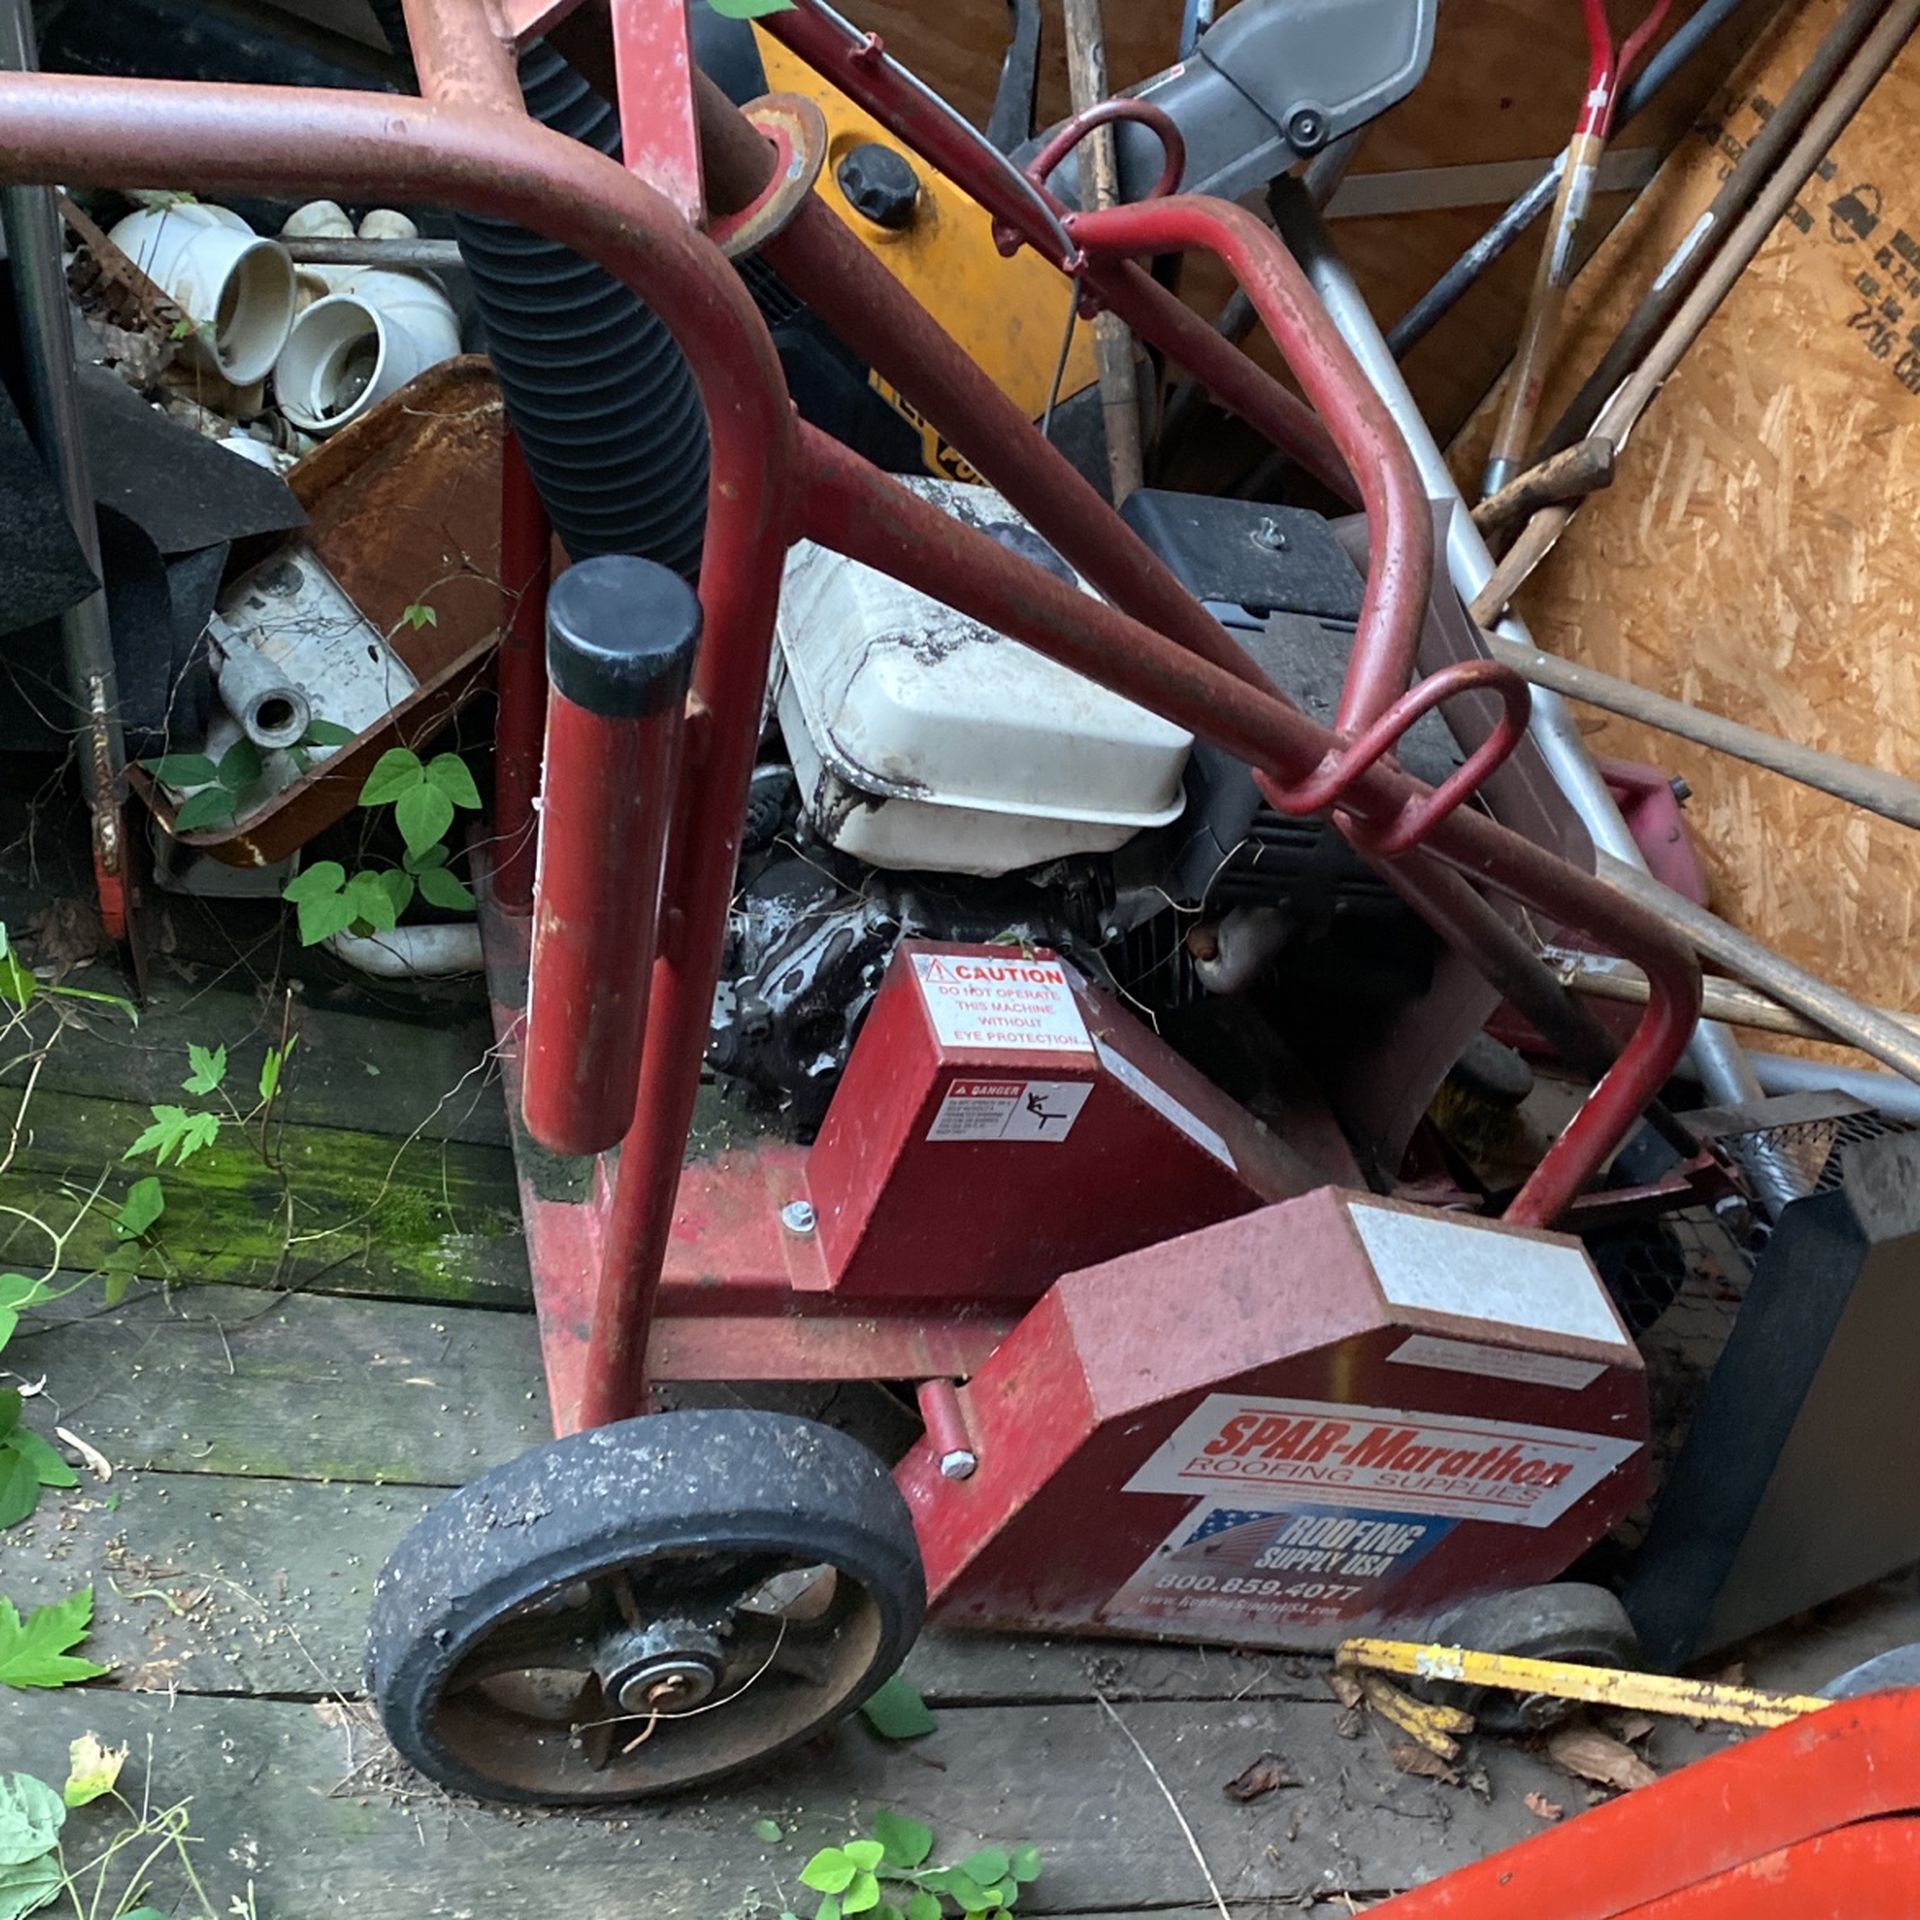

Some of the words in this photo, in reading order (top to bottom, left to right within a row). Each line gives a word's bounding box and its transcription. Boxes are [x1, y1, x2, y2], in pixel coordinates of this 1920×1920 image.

[955, 965, 1064, 985] CAUTION
[938, 986, 961, 997] DO
[963, 986, 992, 998] NOT
[995, 988, 1061, 1001] OPERATE
[957, 1000, 988, 1011] THIS
[991, 1002, 1056, 1014] MACHINE
[978, 1016, 1042, 1028] WITHOUT
[954, 1030, 983, 1041] EYE
[987, 1031, 1079, 1045] PROTECTION
[971, 1085, 1020, 1096] DANGER
[1203, 1414, 1574, 1488] SPAR-Marathon
[1185, 1456, 1354, 1482] ROOFING
[1374, 1473, 1544, 1502] SUPPLIES
[1275, 1514, 1427, 1555] ROOFING
[1253, 1546, 1344, 1575] SUPPLY
[1339, 1552, 1396, 1578] USA
[1154, 1572, 1362, 1601] 800.859.4077
